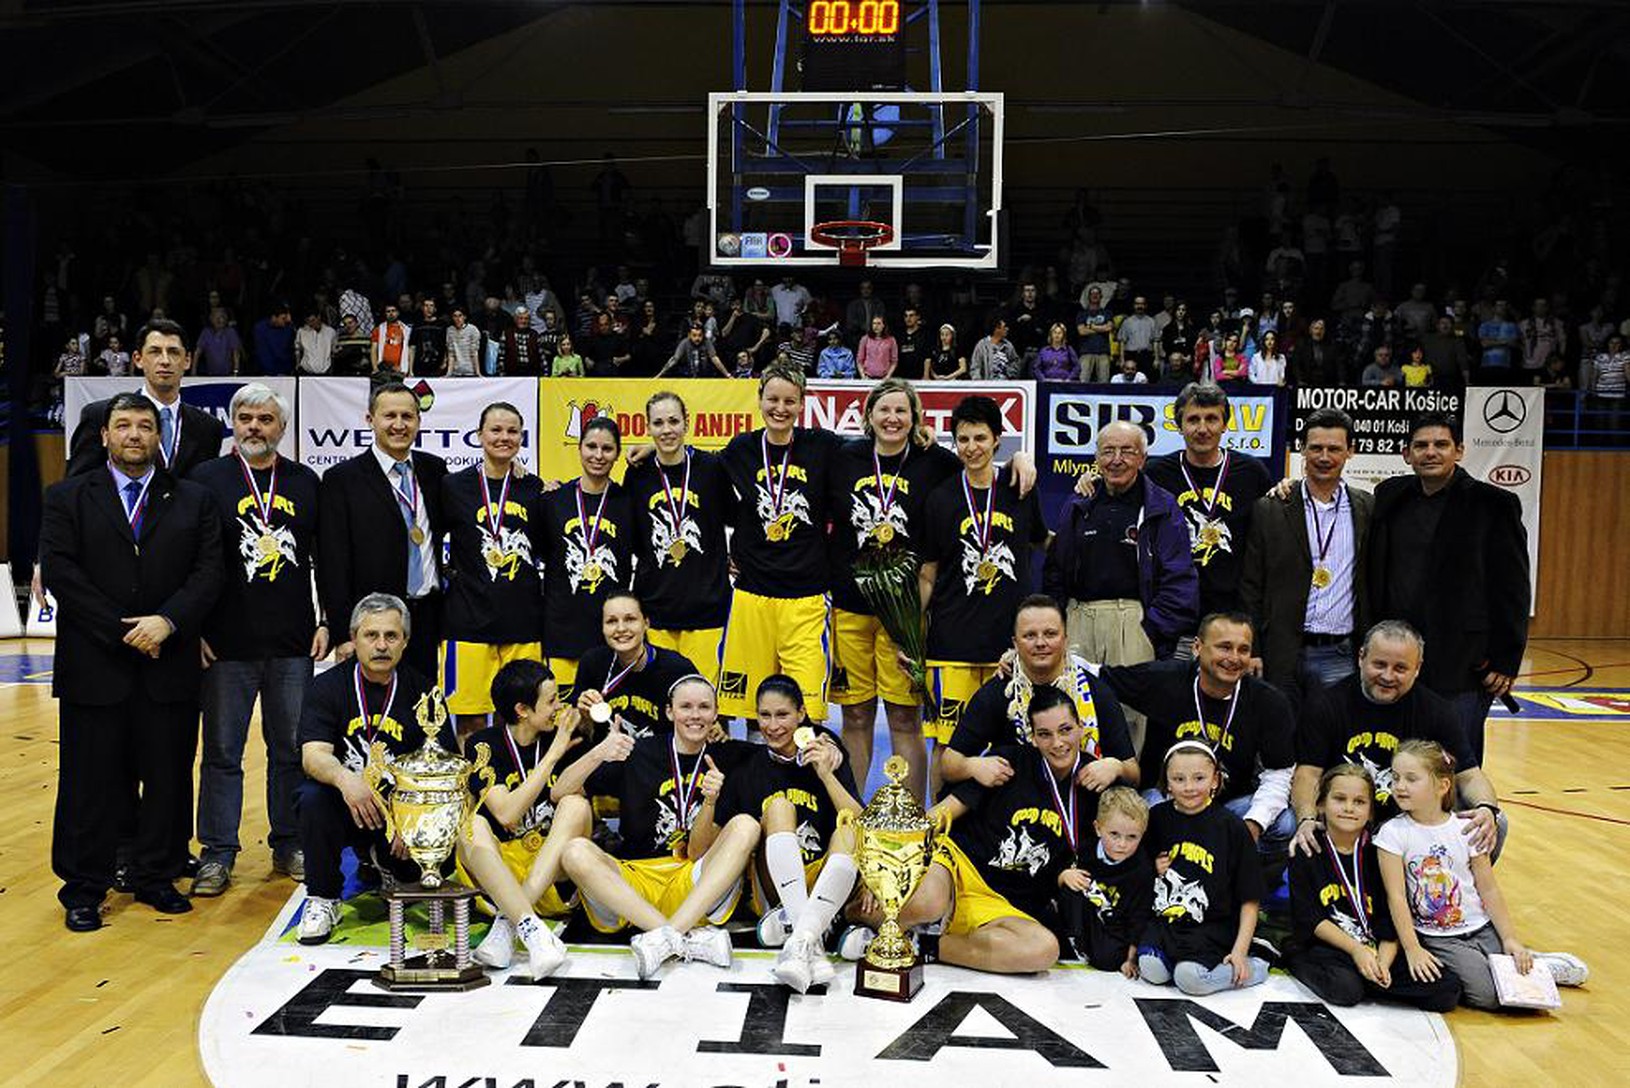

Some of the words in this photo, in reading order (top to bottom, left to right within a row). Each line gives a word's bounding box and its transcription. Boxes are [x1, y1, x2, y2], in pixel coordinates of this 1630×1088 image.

[1297, 387, 1400, 411] MOTOR-CAR
[1404, 389, 1459, 412] Košice
[693, 412, 755, 437] ANJEL
[1353, 419, 1371, 433] 040
[1373, 419, 1385, 433] 01
[1387, 419, 1410, 434] Koši
[1226, 437, 1265, 449] s.r.o.
[1377, 438, 1394, 453] 82
[1495, 469, 1524, 481] KIA
[250, 968, 1393, 1077] ETIAM
